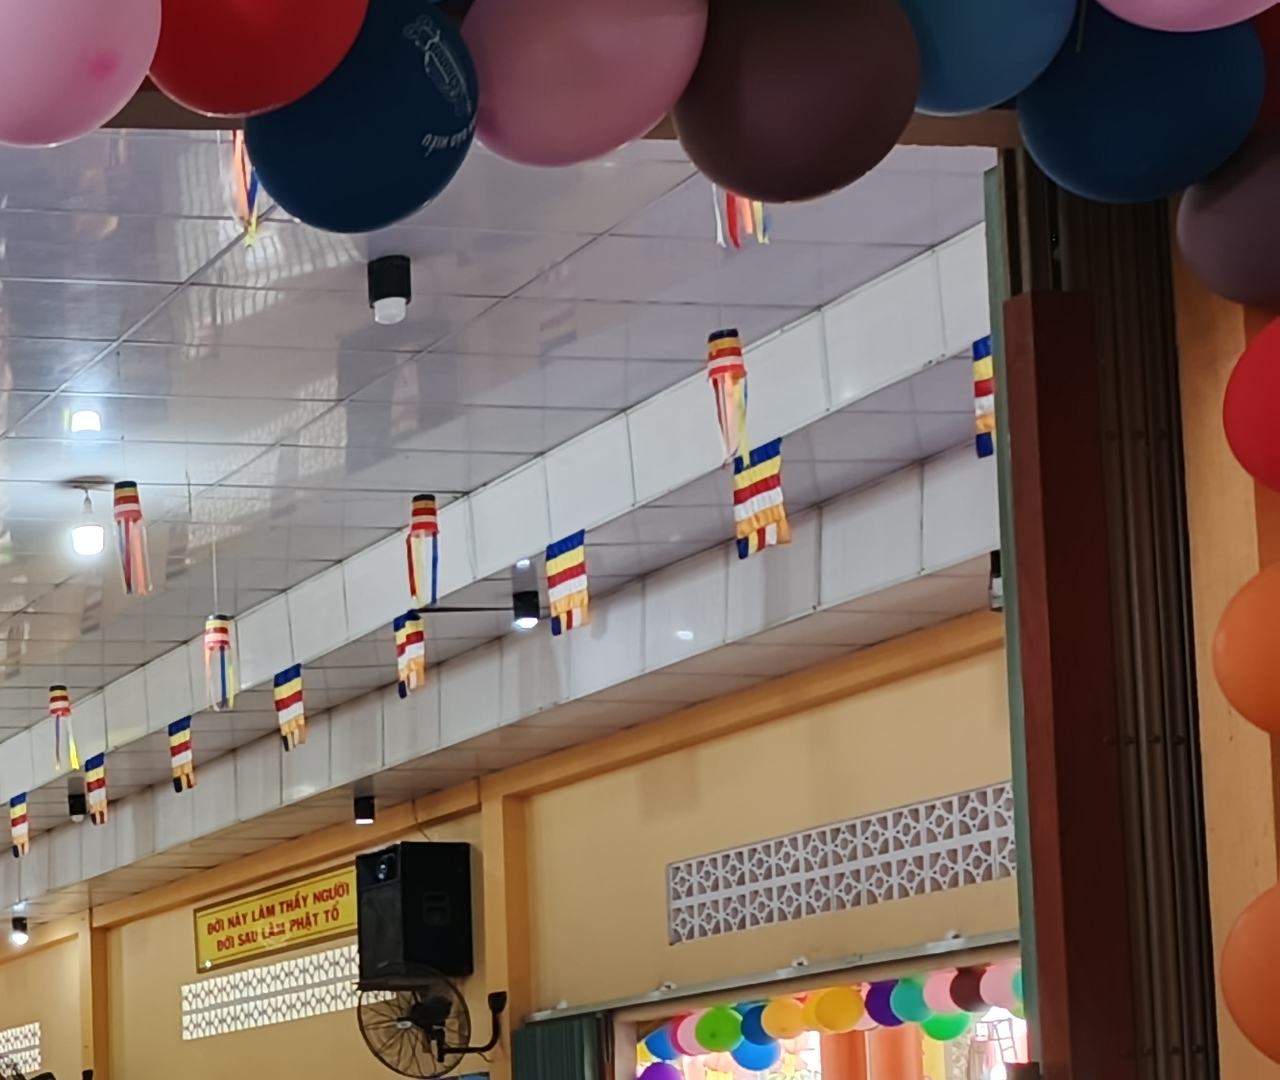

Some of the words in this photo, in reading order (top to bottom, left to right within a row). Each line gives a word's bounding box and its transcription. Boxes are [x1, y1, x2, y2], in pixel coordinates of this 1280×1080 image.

[207, 916, 225, 935] ĐỜI
[227, 910, 249, 930] NÀY
[251, 904, 276, 922] LÀM
[216, 934, 235, 952] ĐỜI
[237, 930, 258, 947] SAU
[289, 911, 320, 932] PHẬT
